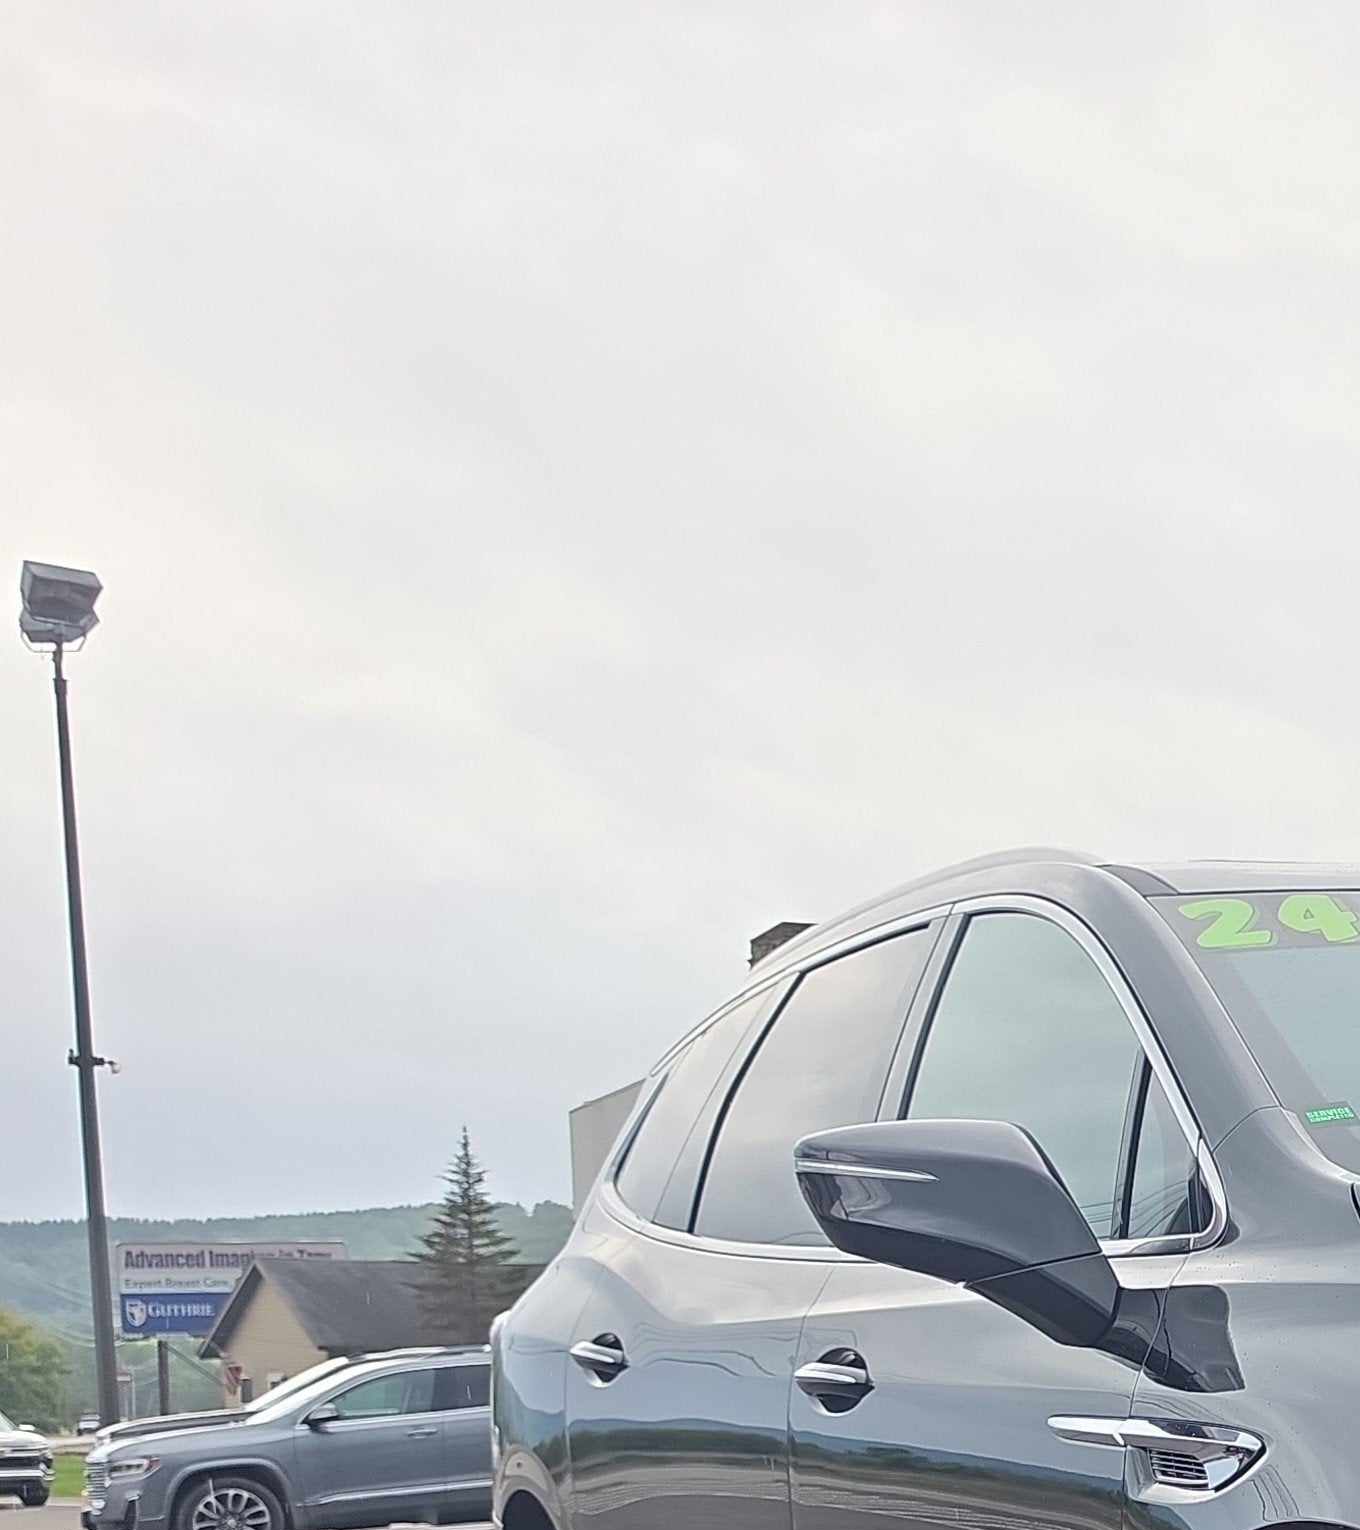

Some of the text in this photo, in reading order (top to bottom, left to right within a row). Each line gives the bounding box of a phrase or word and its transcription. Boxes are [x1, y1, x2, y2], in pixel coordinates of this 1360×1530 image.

[1178, 894, 1360, 948] 24
[1305, 1106, 1351, 1119] SERVICE
[124, 1250, 206, 1269] Advanced
[209, 1250, 275, 1270] Imagi
[148, 1302, 216, 1318] GUTHRIE
